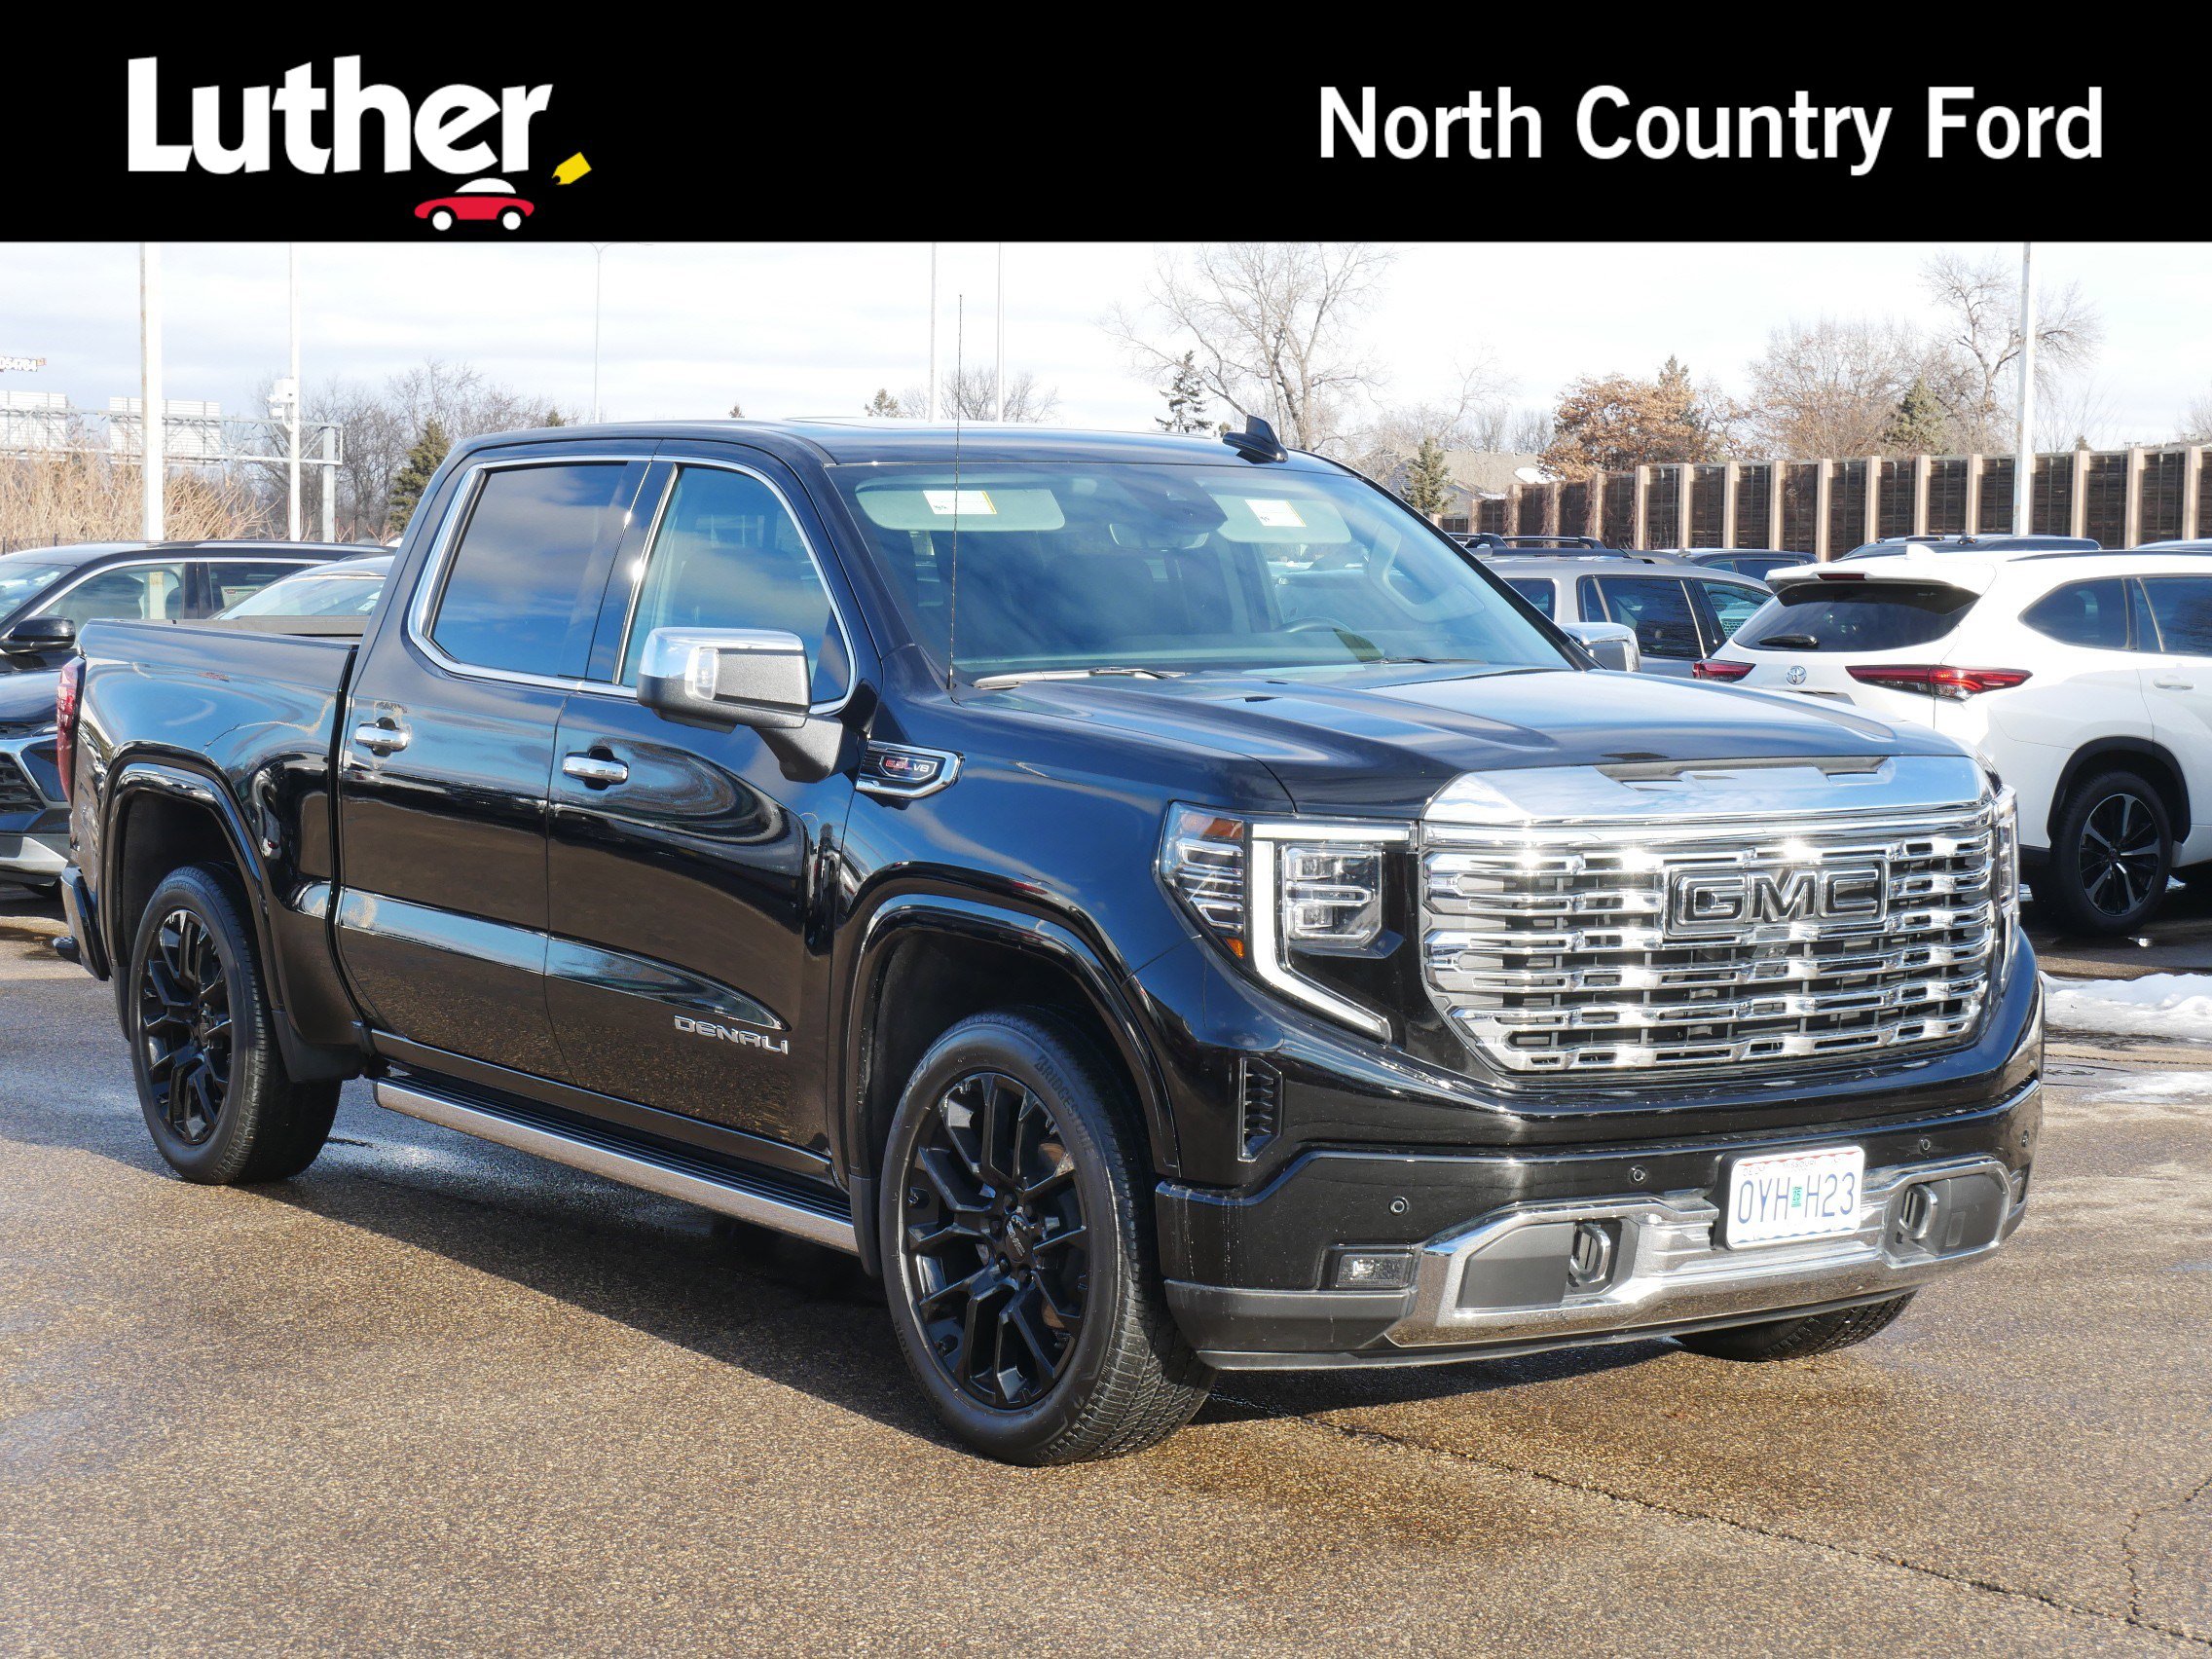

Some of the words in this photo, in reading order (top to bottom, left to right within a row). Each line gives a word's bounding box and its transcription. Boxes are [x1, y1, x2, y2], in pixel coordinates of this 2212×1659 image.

[913, 763, 930, 773] V8
[1673, 867, 1879, 926] GMC
[674, 1014, 789, 1055] DENALI
[1804, 1171, 1856, 1218] H23
